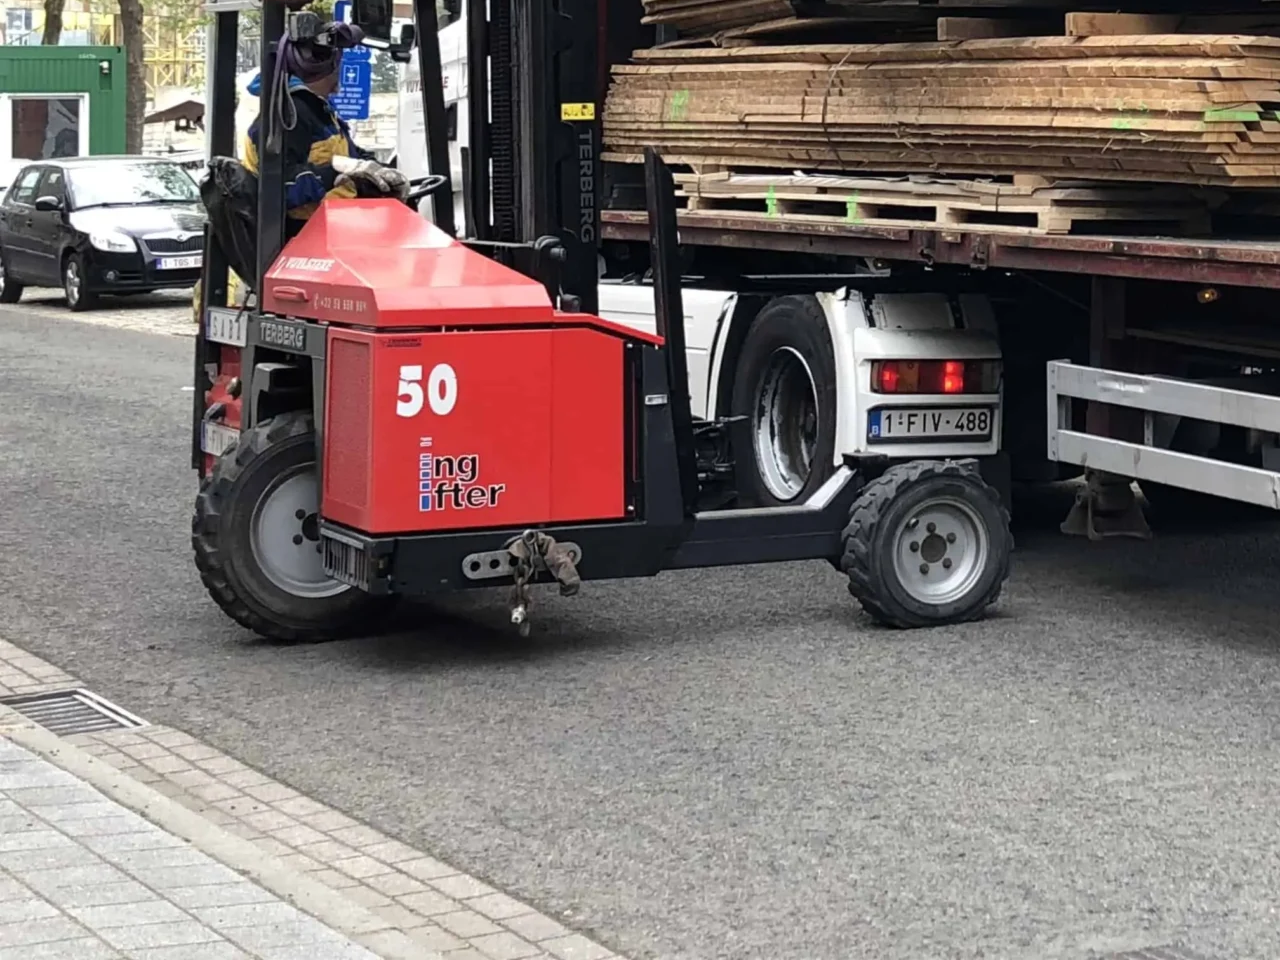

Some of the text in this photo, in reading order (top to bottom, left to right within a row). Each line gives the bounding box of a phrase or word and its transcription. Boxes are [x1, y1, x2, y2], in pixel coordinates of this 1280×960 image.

[579, 129, 594, 243] TERBERG
[260, 322, 304, 349] TERBERG
[396, 363, 458, 417] 50
